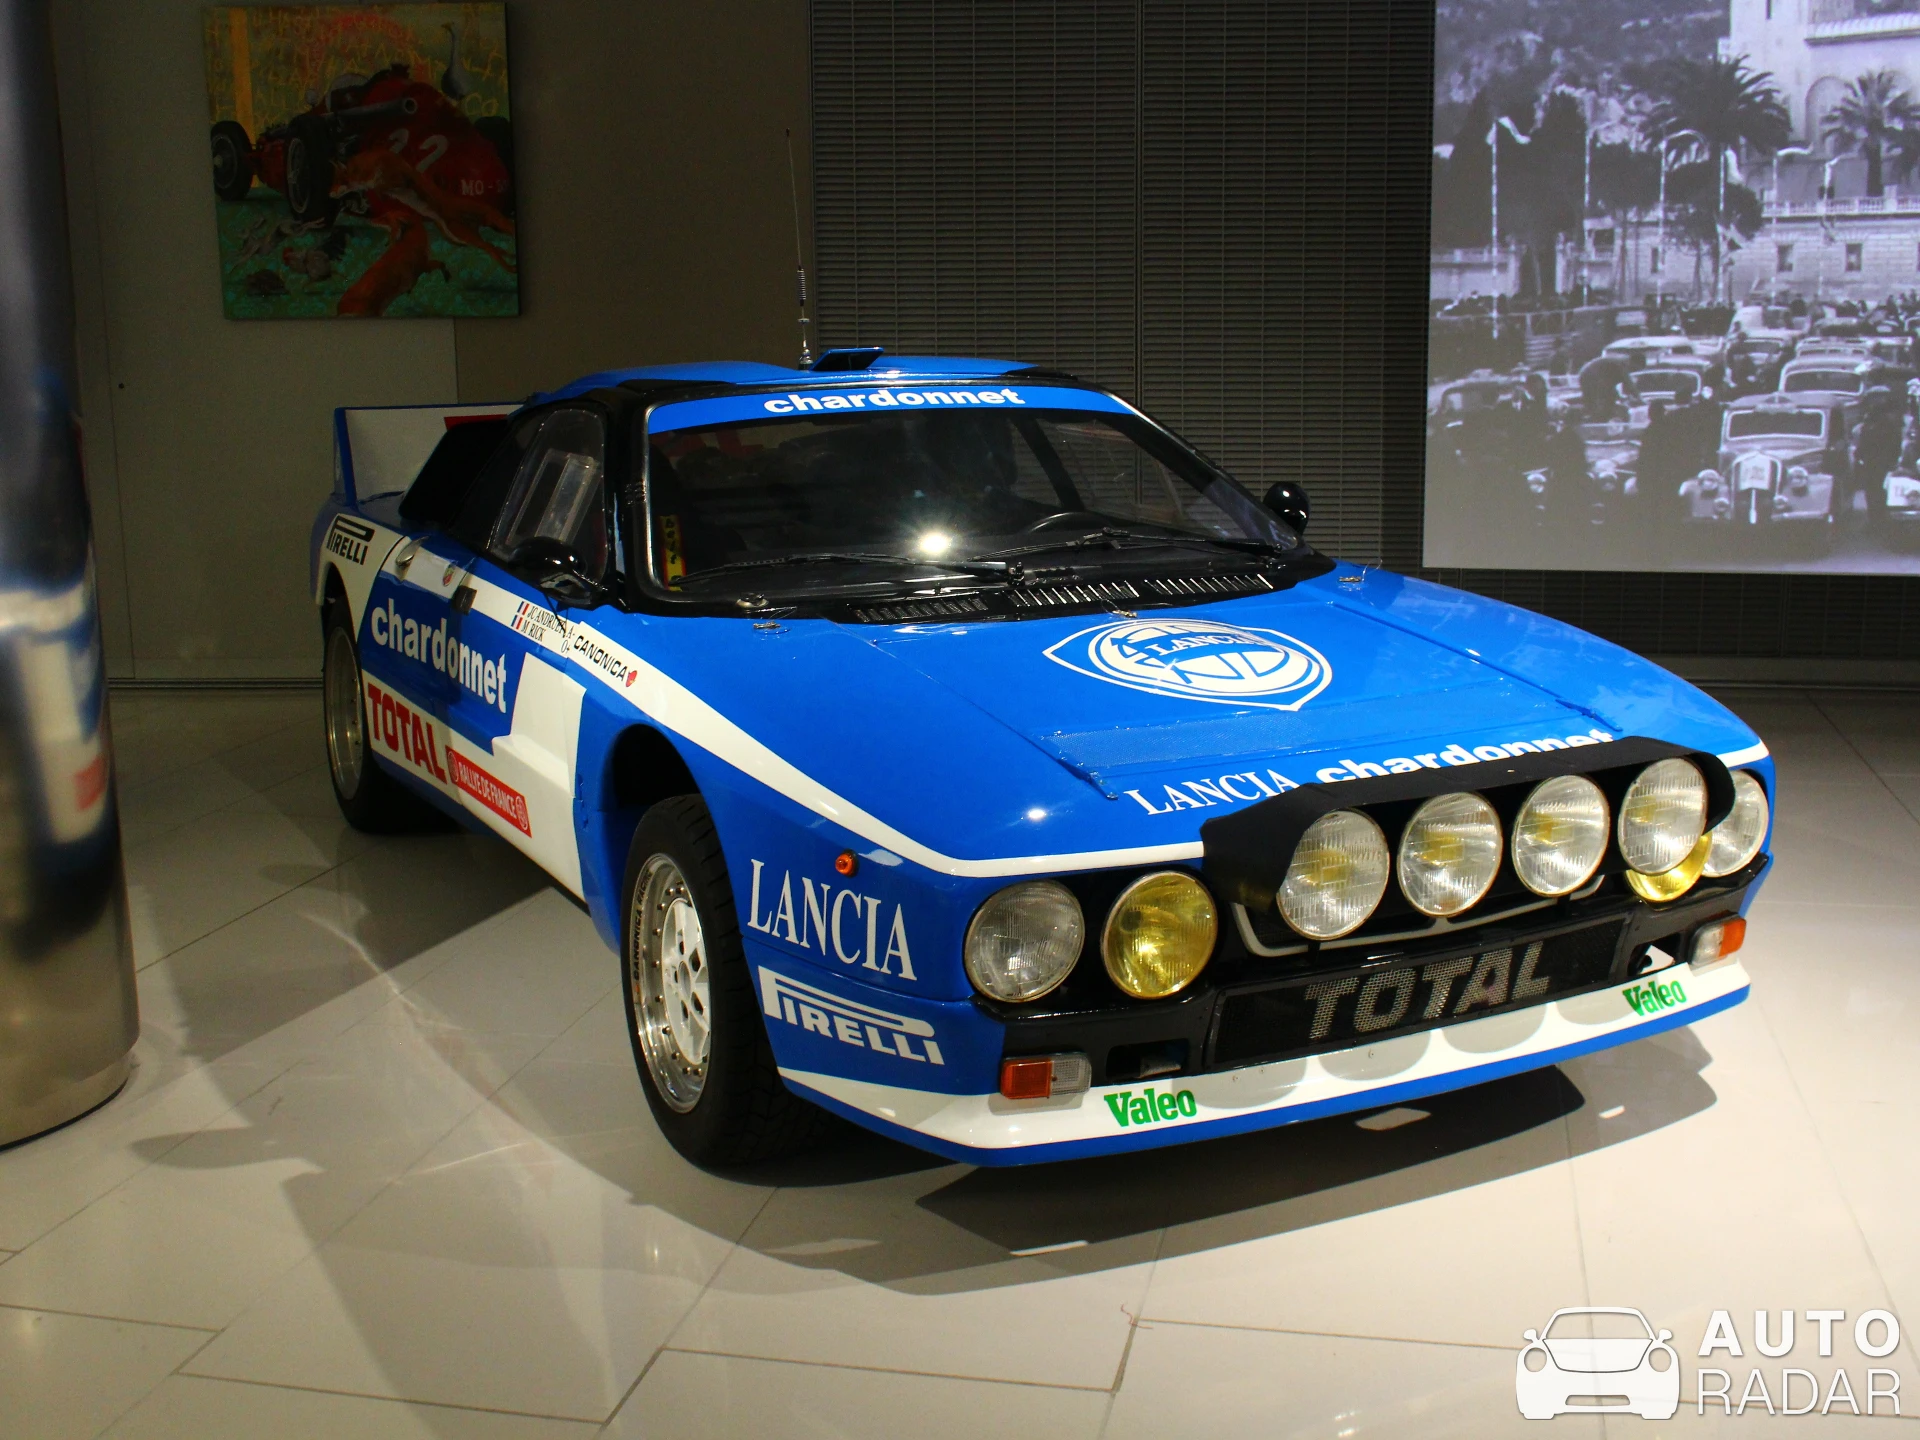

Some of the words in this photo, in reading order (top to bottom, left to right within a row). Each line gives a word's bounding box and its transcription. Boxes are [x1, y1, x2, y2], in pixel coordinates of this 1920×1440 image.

[763, 388, 1026, 413] chardonnet
[326, 515, 375, 565] PIRELLI
[370, 598, 508, 714] chardonnet
[573, 635, 628, 681] CANONICA
[367, 681, 448, 785] TOTAL
[1124, 768, 1301, 815] LANCIA
[1316, 728, 1614, 784] chardonnet
[747, 859, 917, 981] LANCIA
[758, 965, 945, 1065] PIRELLI
[1303, 940, 1551, 1041] TOTAL
[1622, 979, 1688, 1017] Valeo
[1104, 1088, 1197, 1127] Valeo
